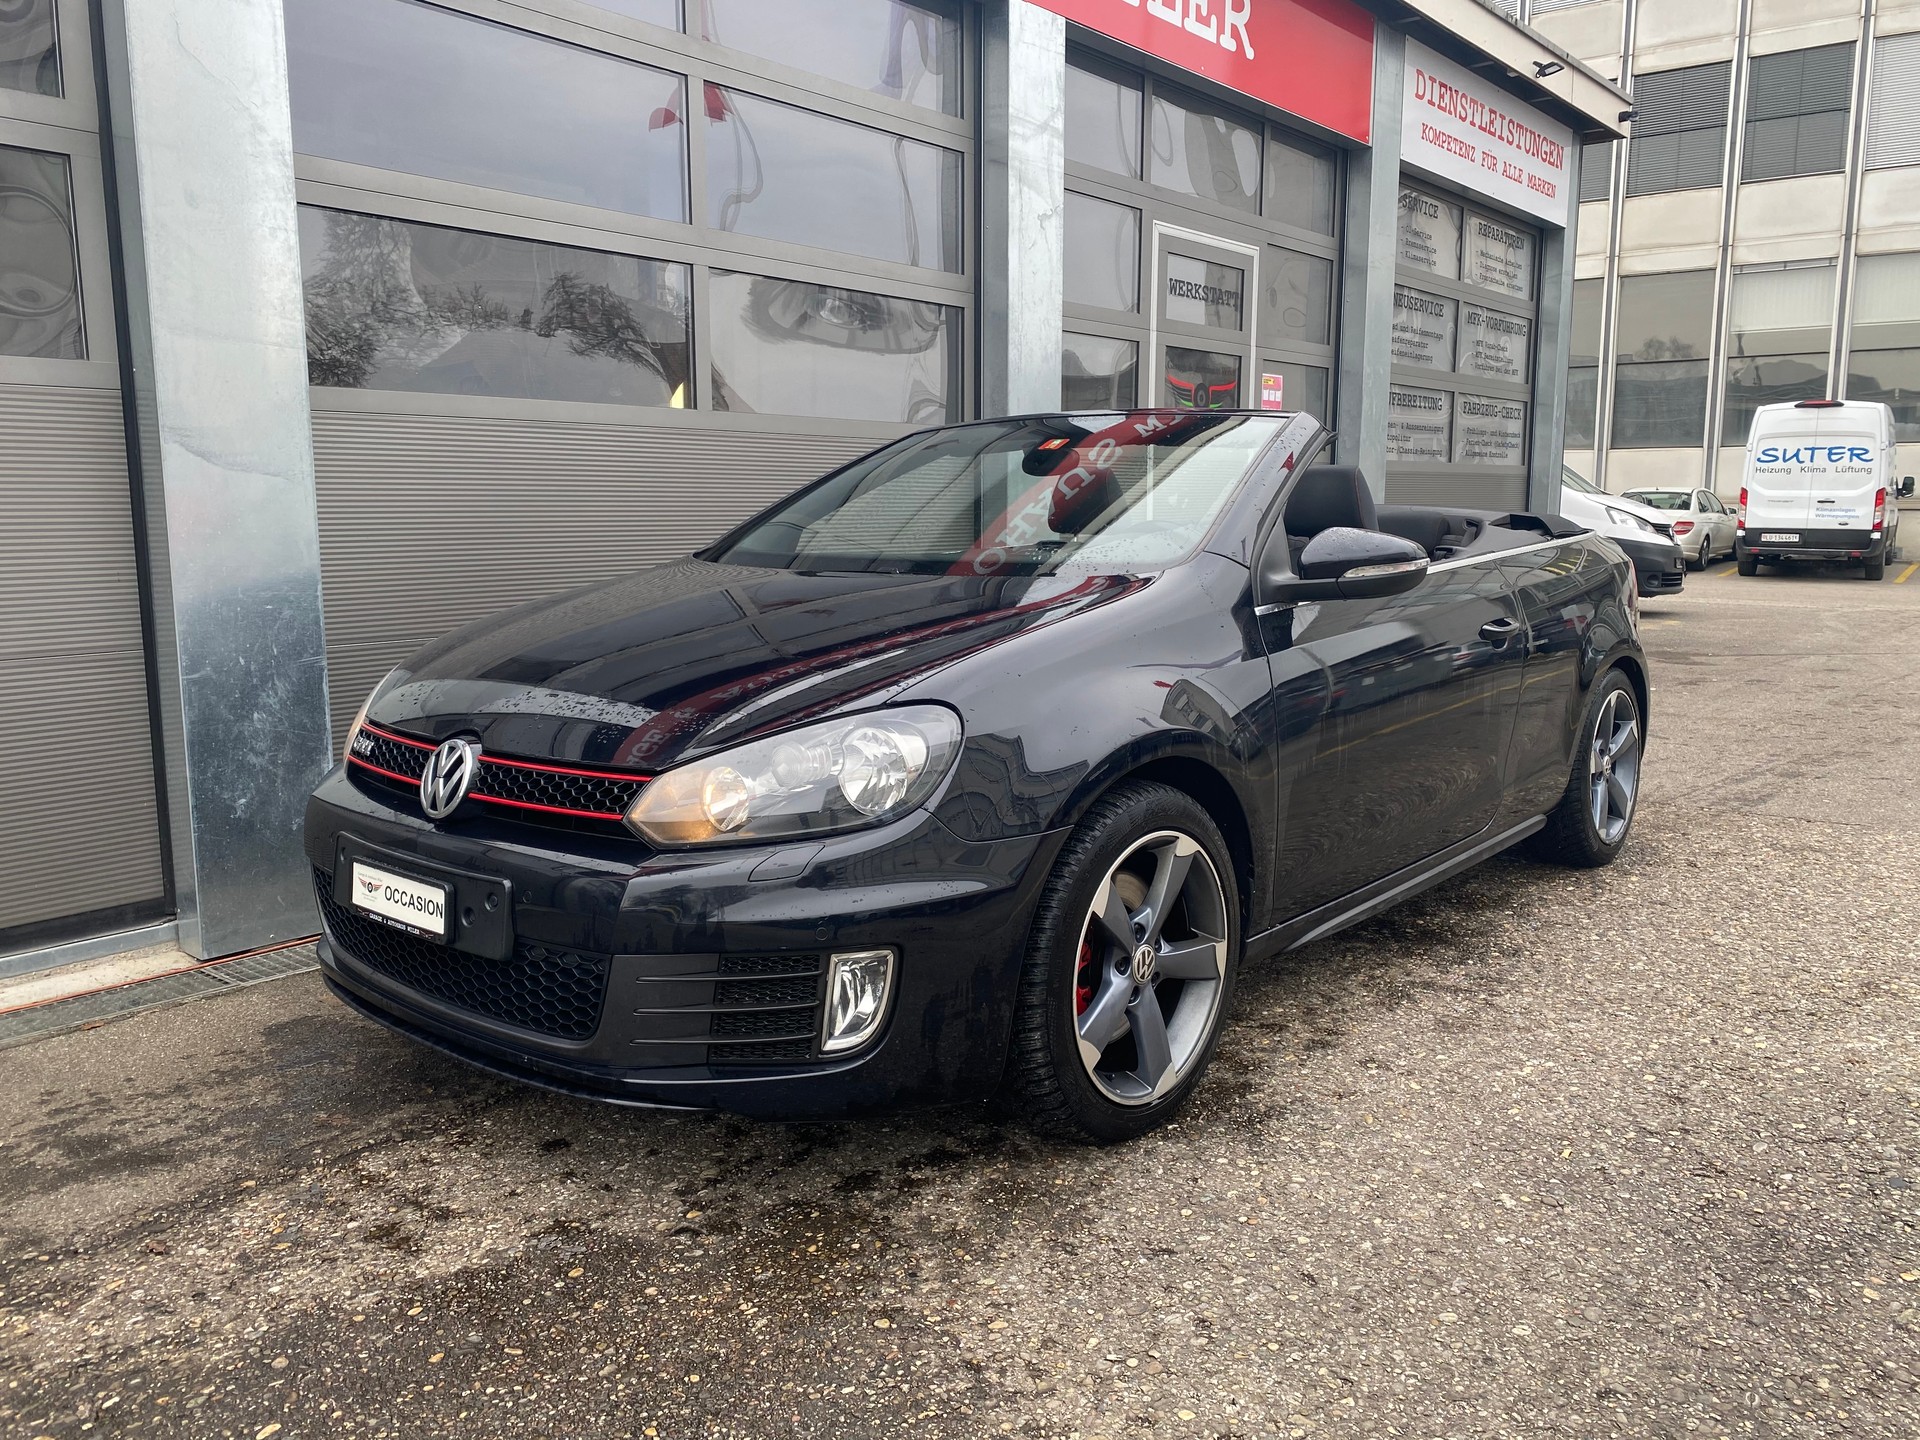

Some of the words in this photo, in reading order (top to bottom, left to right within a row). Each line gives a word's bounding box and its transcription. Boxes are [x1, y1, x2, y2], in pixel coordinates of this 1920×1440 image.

[1414, 68, 1565, 171] DIENSTLEISTUNGEN
[1420, 122, 1476, 163] KOMPETENZ
[1481, 149, 1498, 173] FÜR
[1501, 161, 1524, 184] ALLE
[1527, 173, 1557, 199] MARKEN
[1402, 193, 1439, 219] SERVICE
[1478, 222, 1525, 250] REPARATUREN
[1169, 278, 1240, 310] WERKSTATT
[1463, 401, 1522, 421] FAHRZEUG-CHECK
[1756, 446, 1874, 464] SUTER
[1755, 466, 1792, 475] Heizung
[1799, 465, 1827, 473] Klima
[1835, 465, 1872, 475] Lüftung
[384, 885, 444, 919] OCCASION
